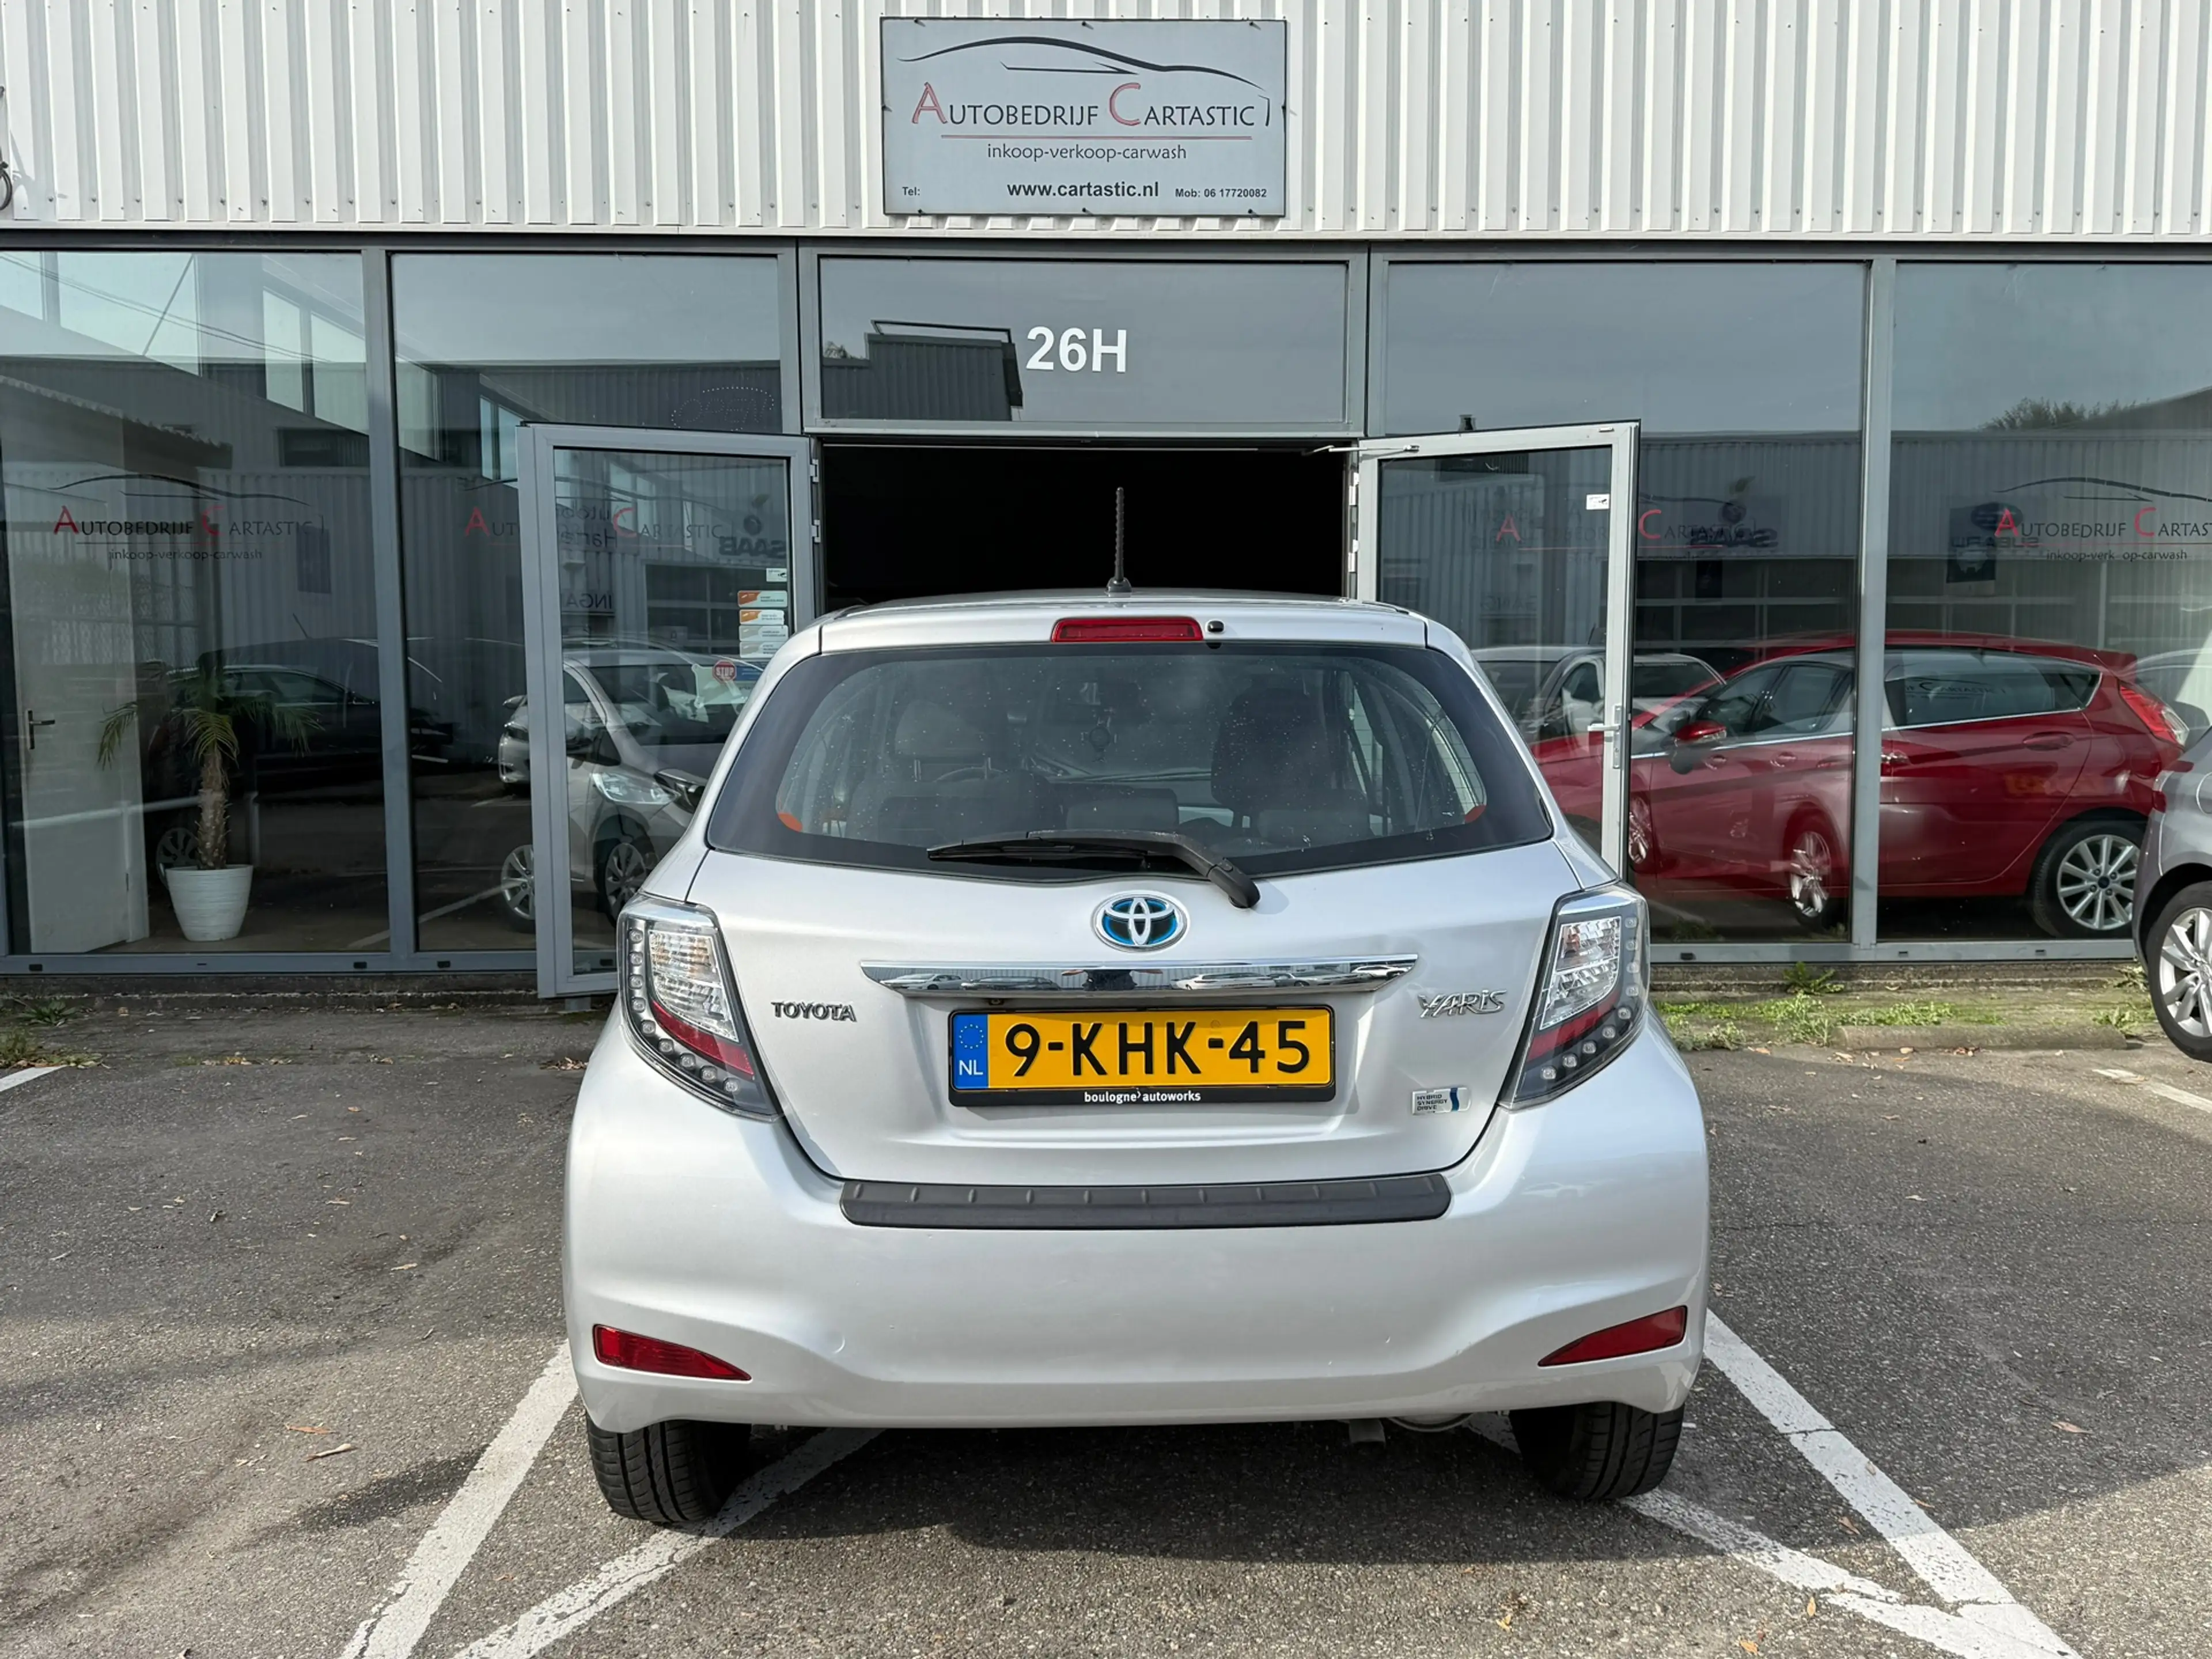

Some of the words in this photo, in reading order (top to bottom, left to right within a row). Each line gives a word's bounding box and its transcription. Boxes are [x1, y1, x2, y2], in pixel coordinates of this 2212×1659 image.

[911, 82, 1099, 126] AUTOBEDRIJF
[1109, 82, 1255, 126] CARTASTIC
[987, 143, 1187, 162] inkoop-verkoop-carwash
[902, 186, 921, 196] Tel:
[1007, 181, 1159, 198] www.cartastic.nl
[1175, 188, 1201, 198] Mob:
[1204, 188, 1216, 198] 06
[1219, 188, 1267, 198] 17720082
[1025, 326, 1127, 373] 26H
[1994, 507, 2126, 538] AUTOBEDRIJF
[771, 1001, 857, 1022] TOYOTA
[1418, 990, 1508, 1018] YARIS
[1005, 1020, 1309, 1077] 9-KHK-45
[959, 1059, 983, 1075] NL
